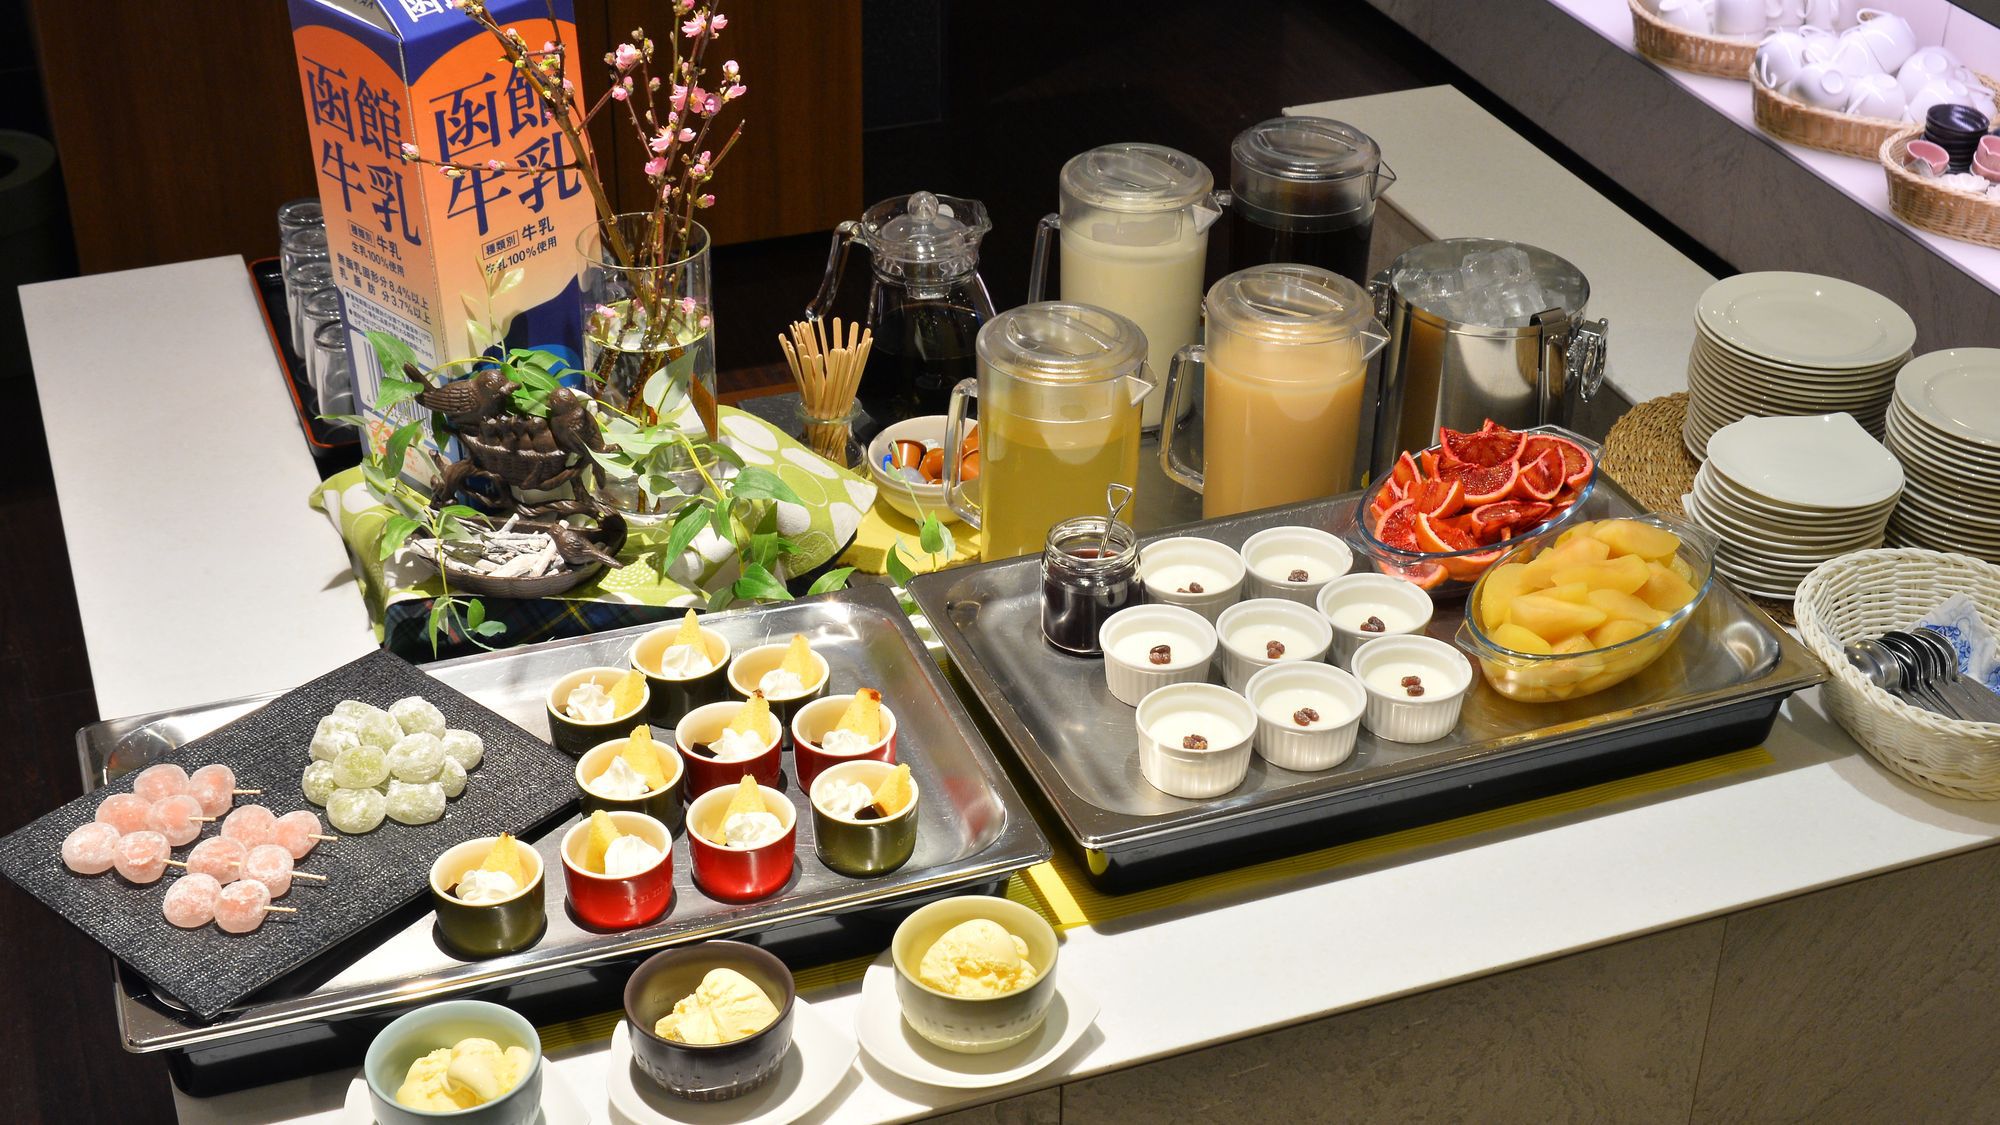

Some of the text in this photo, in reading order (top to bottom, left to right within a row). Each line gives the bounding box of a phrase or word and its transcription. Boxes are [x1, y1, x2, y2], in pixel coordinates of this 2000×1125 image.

[303, 56, 406, 166] 函館
[322, 139, 421, 246] 牛乳
[447, 131, 582, 236] 牛乳
[486, 216, 555, 256] 種類別 牛乳
[376, 233, 402, 261] 牛乳
